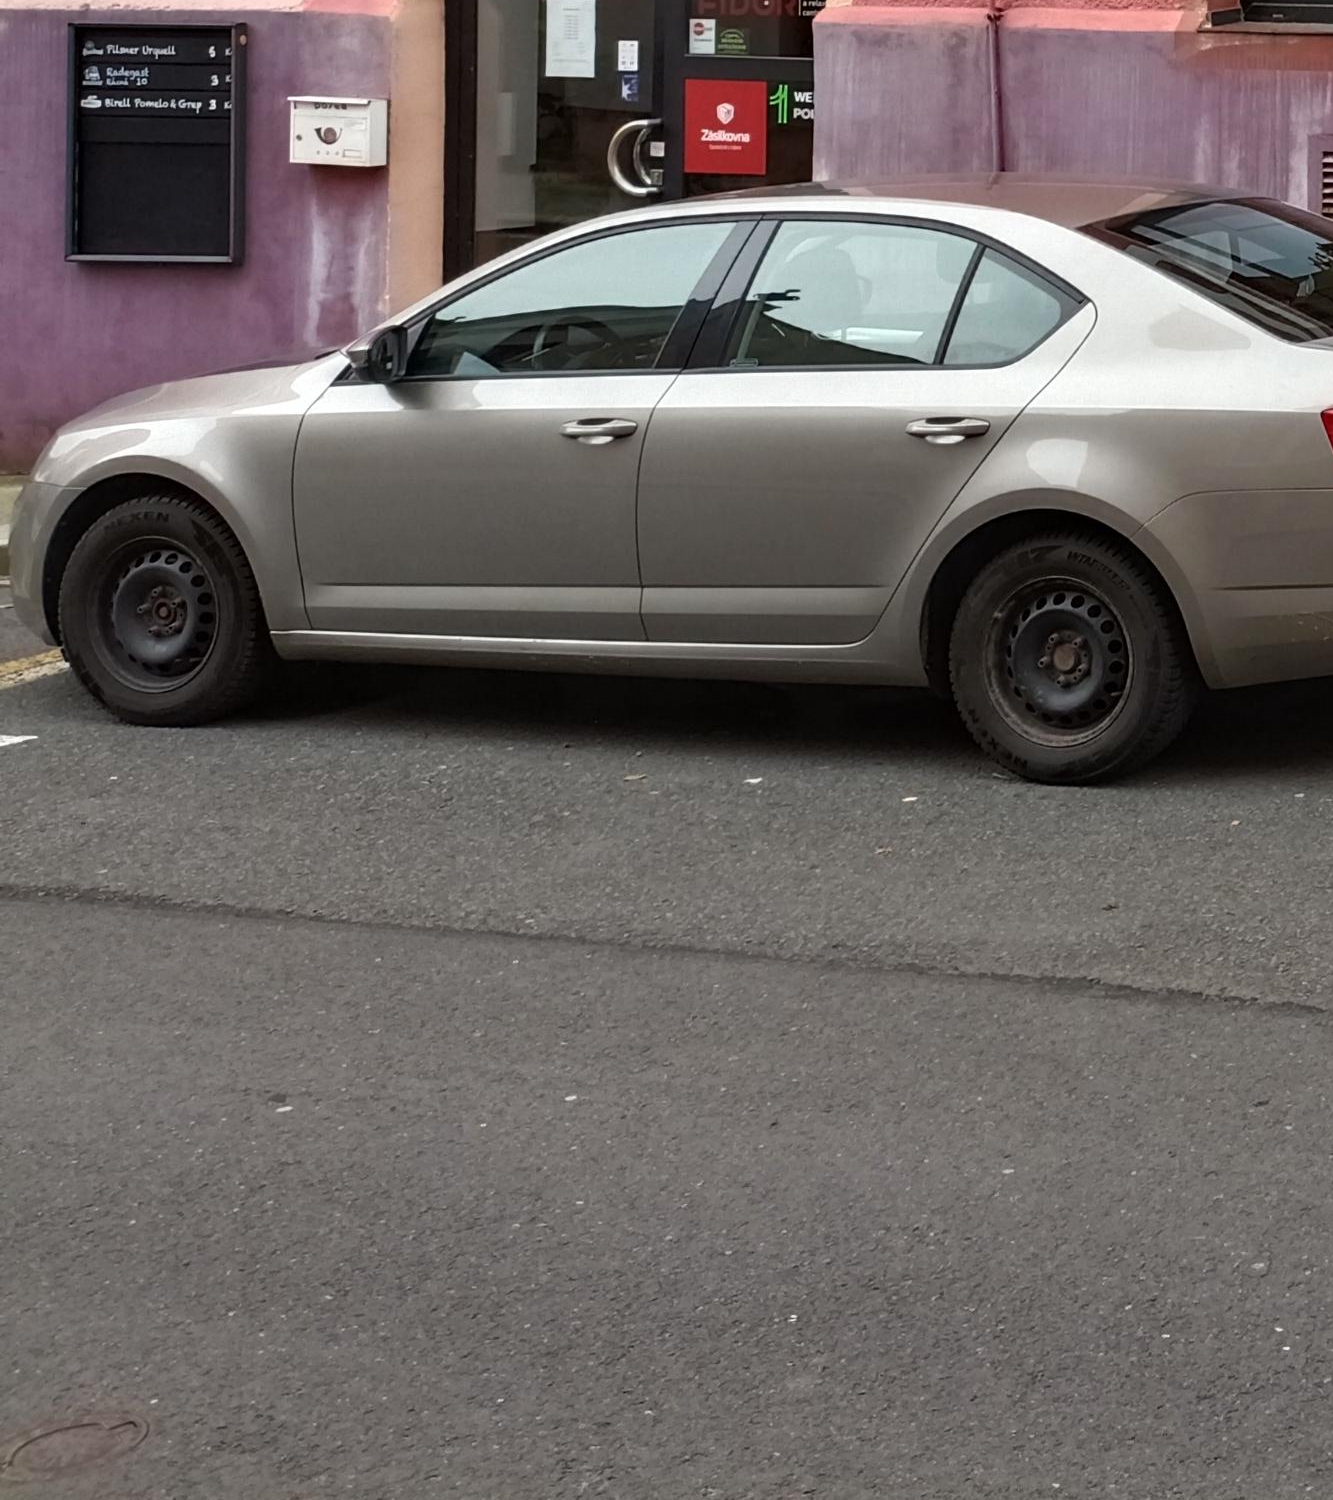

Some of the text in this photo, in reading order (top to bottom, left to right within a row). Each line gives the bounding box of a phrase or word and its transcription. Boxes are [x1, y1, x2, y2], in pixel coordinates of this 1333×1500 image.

[106, 44, 140, 54] Pilsner
[142, 45, 176, 59] Urquell
[106, 67, 150, 80] Radegast
[136, 78, 148, 86] 10
[793, 91, 813, 103] WE
[105, 98, 131, 108] Birell
[134, 99, 169, 109] Pomelo
[170, 101, 176, 109] &
[700, 128, 751, 143] Zásilkovna
